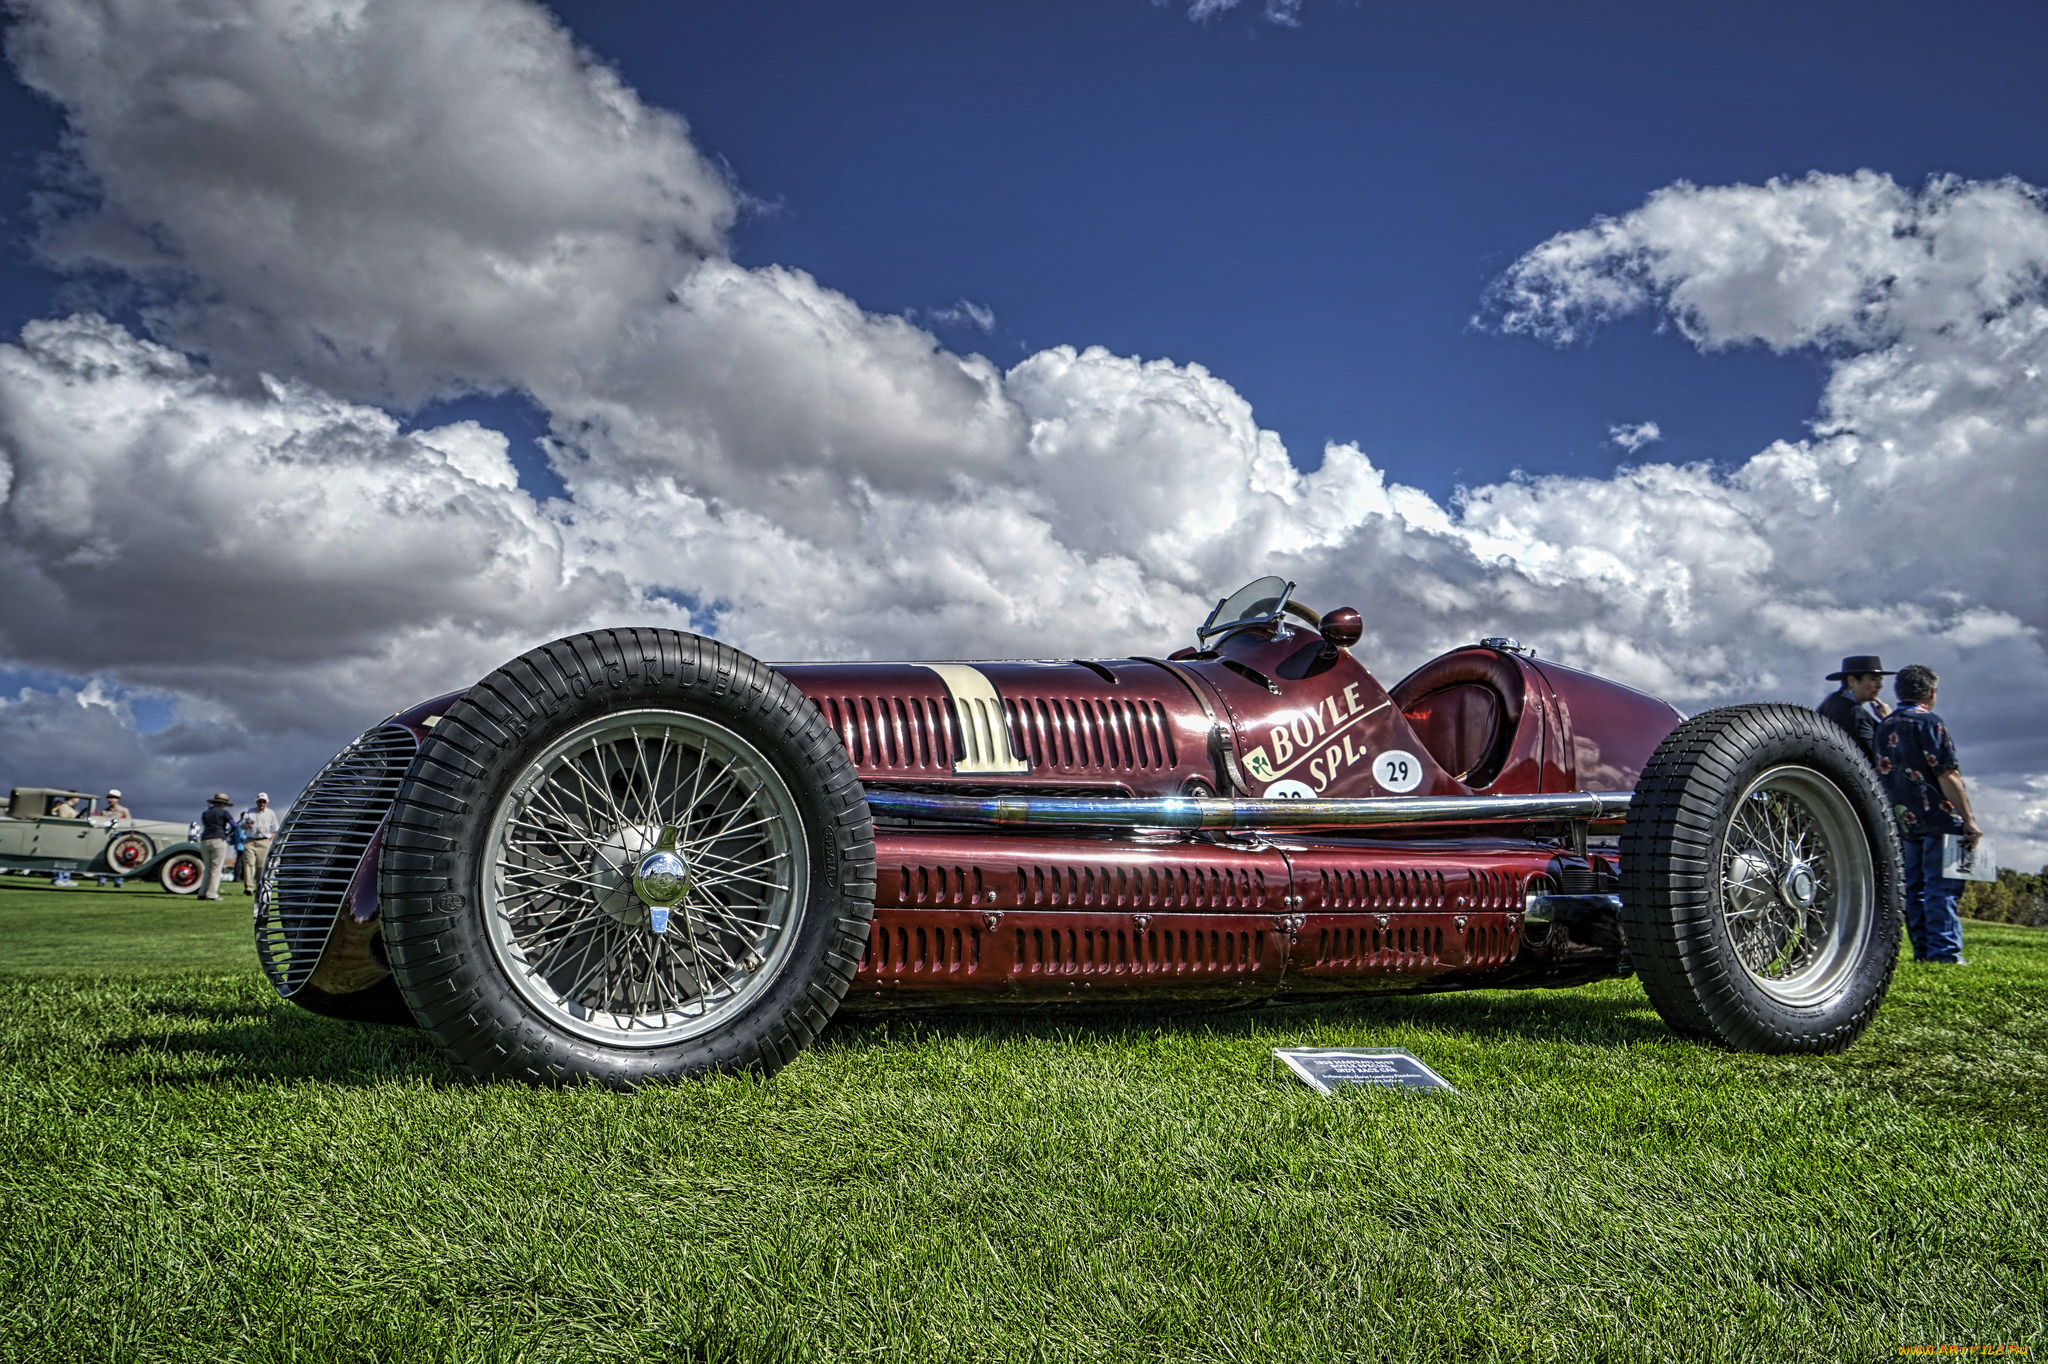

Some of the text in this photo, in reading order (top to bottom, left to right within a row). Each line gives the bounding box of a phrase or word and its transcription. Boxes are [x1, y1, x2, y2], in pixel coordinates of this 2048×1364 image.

[504, 662, 763, 741] BLOCKLEY
[1269, 681, 1365, 765] BOYLE
[1309, 734, 1367, 793] SPL.
[1386, 761, 1409, 782] 29
[825, 832, 837, 881] SPECIAL
